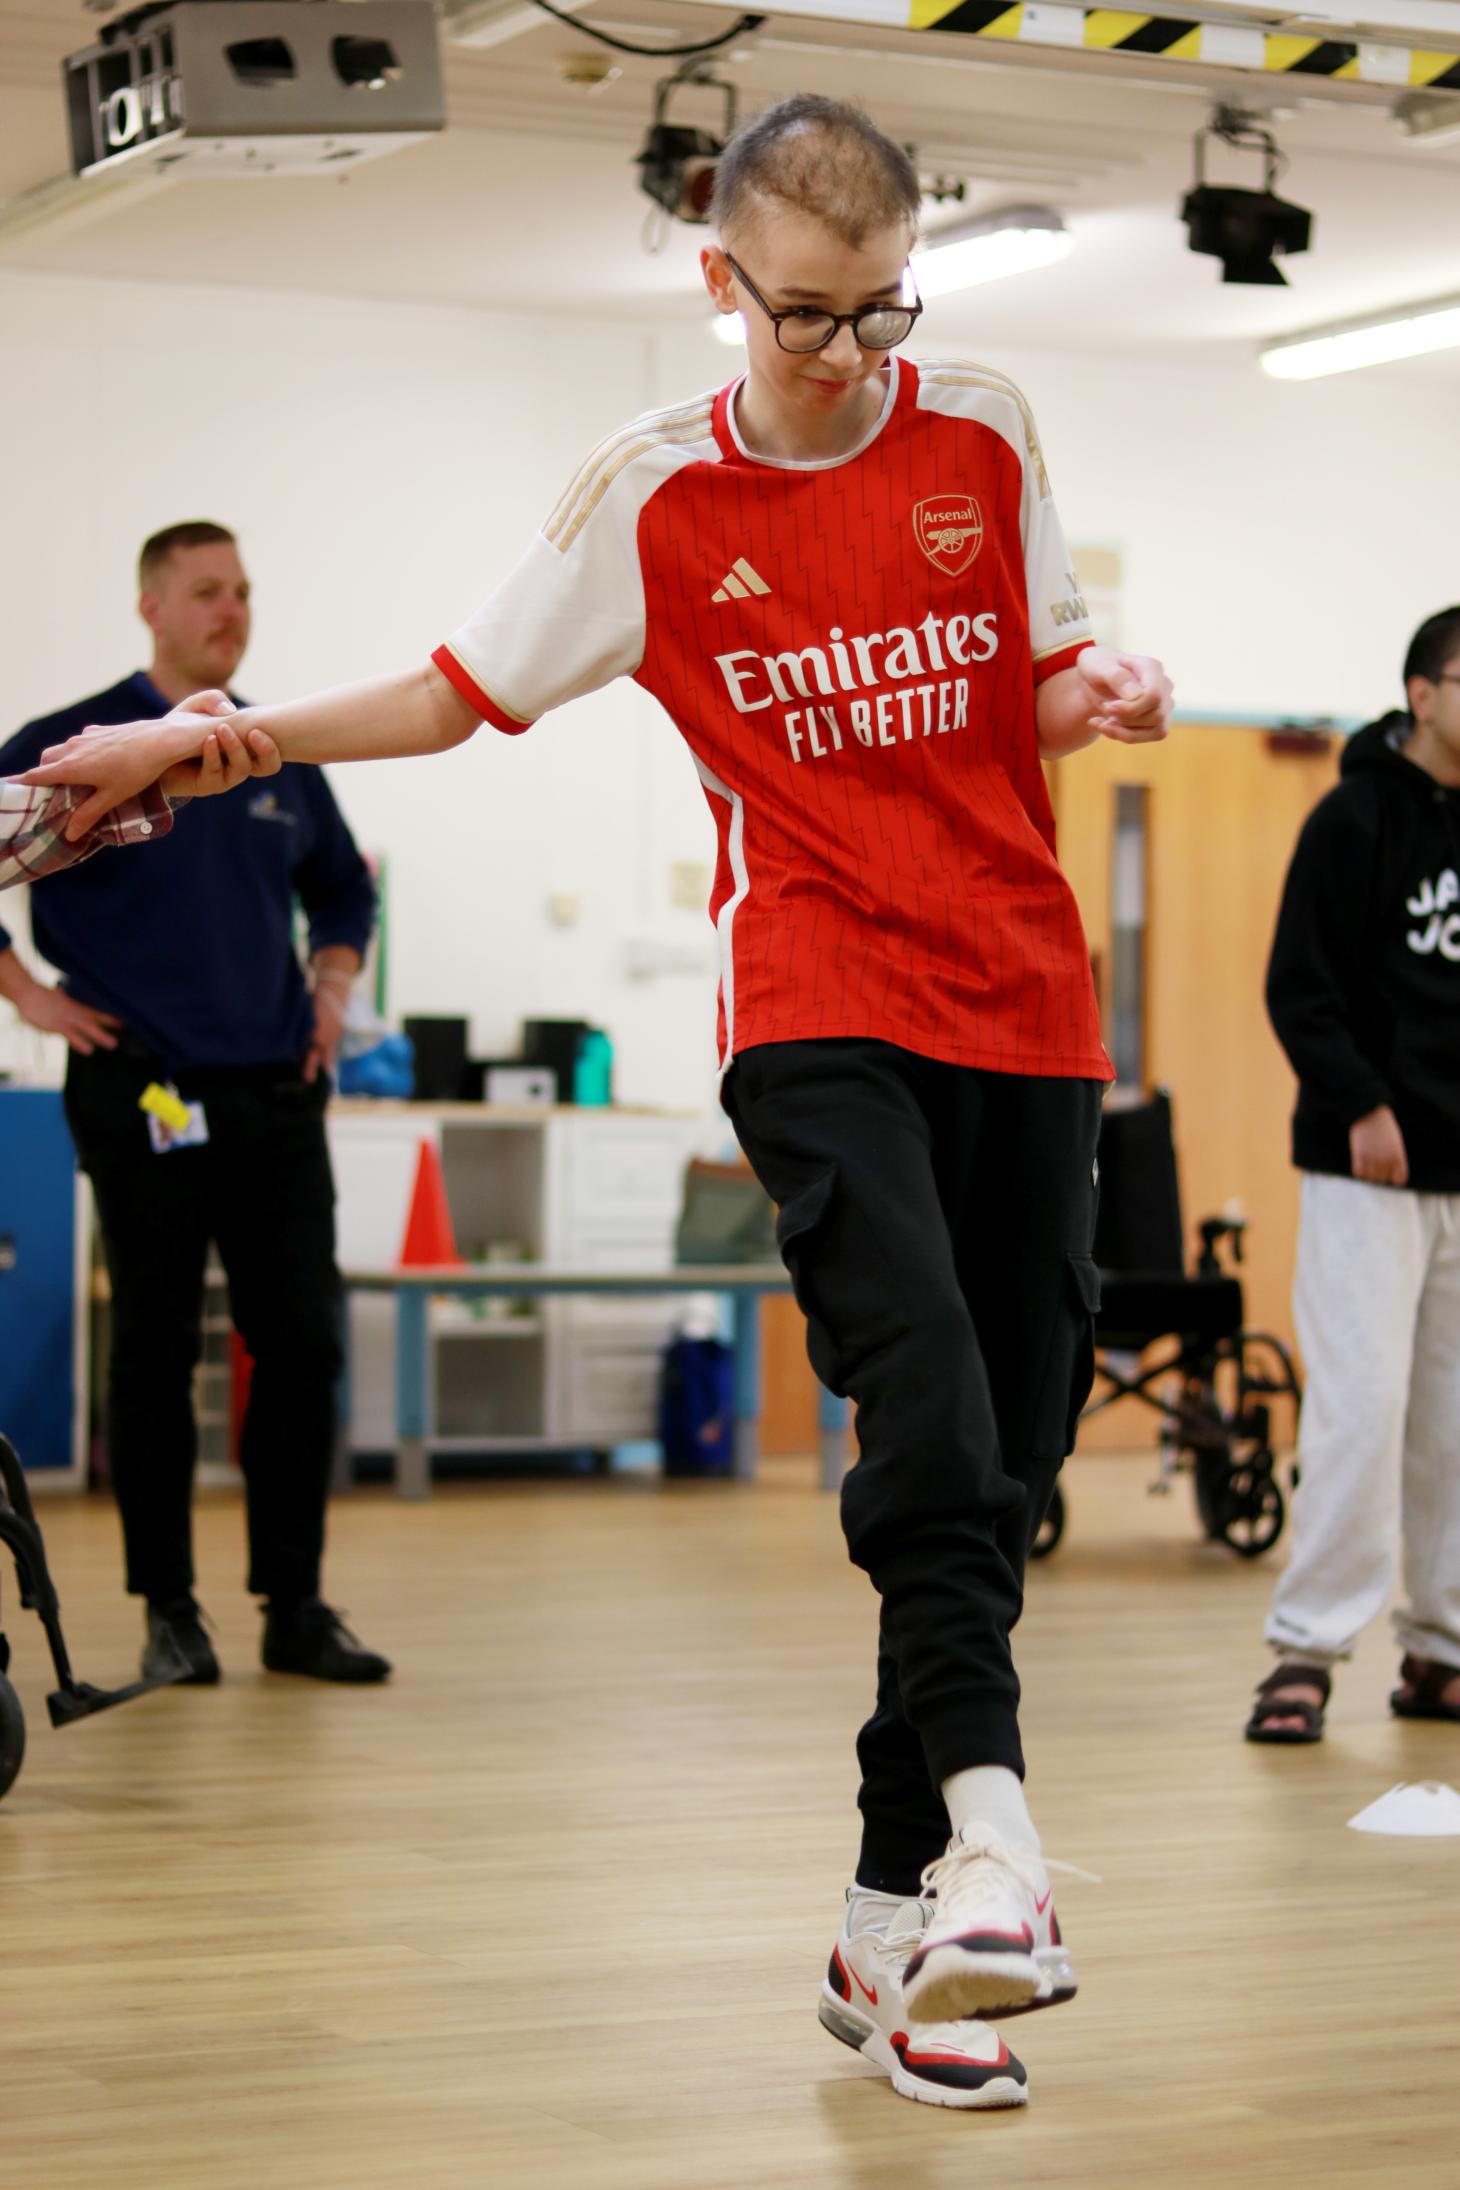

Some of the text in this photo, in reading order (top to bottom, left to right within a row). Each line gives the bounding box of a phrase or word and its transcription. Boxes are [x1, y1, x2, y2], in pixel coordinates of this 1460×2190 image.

[924, 507, 973, 524] Arsenal
[714, 610, 999, 714] Emirates
[784, 678, 969, 763] FLY BETTER
